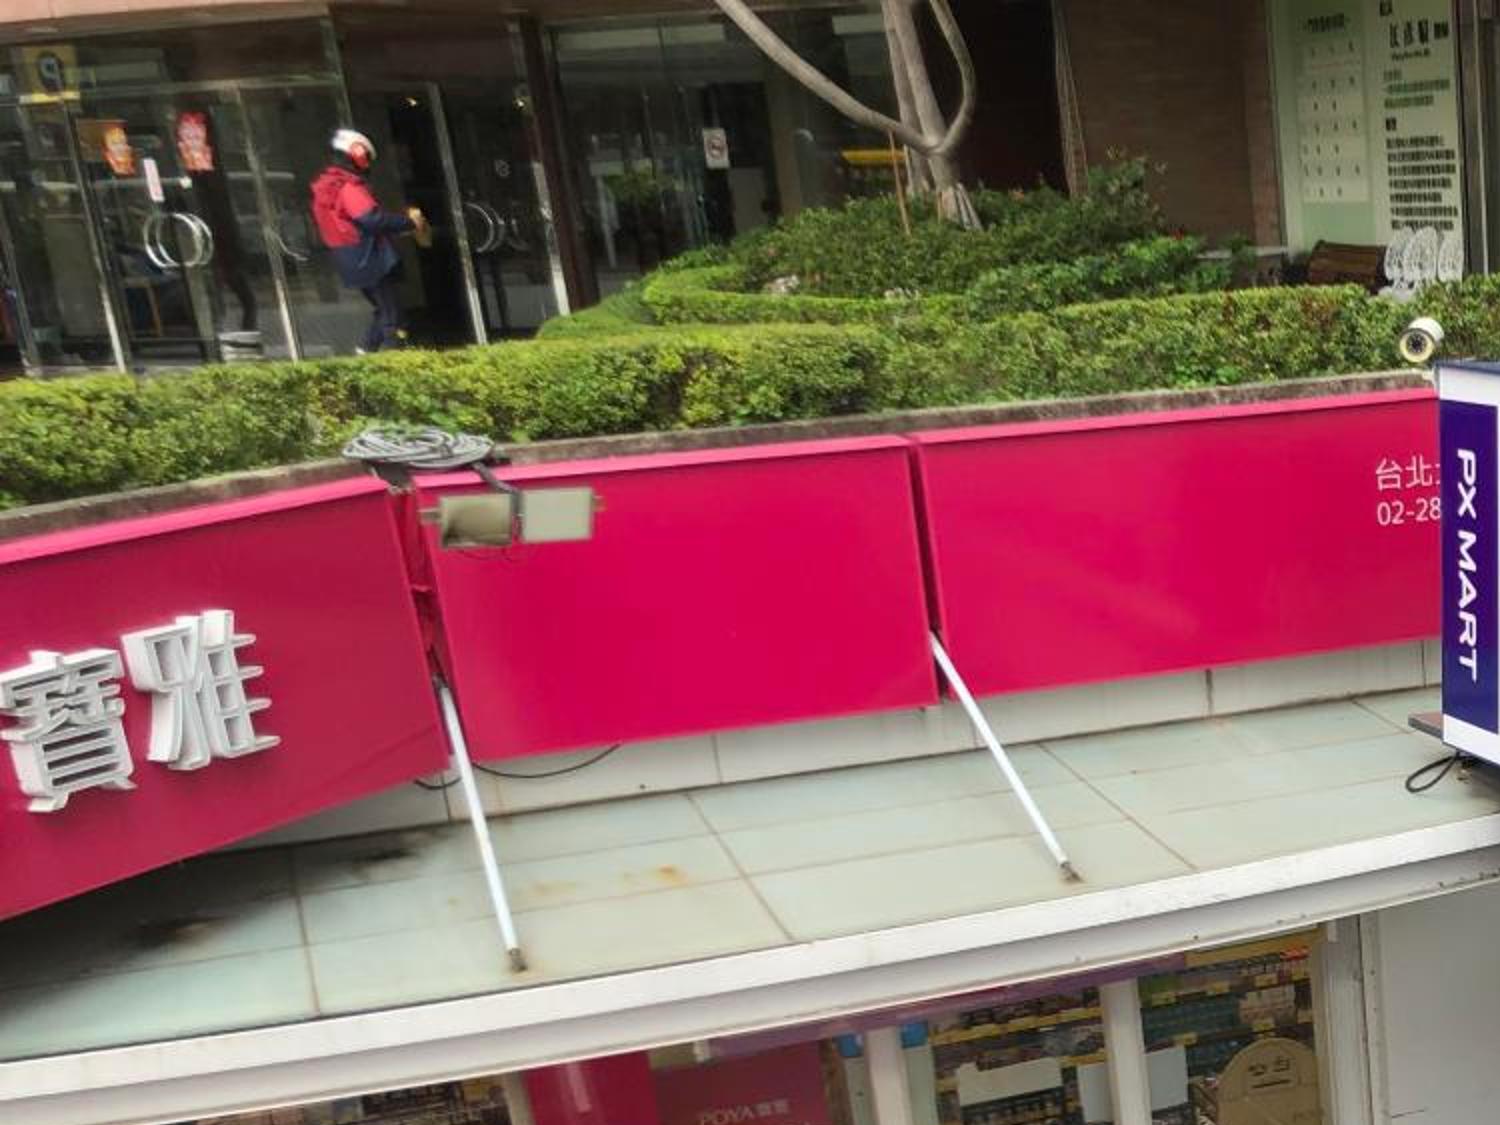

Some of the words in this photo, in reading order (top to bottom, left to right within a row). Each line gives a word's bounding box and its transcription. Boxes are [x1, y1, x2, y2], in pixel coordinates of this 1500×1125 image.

[1376, 454, 1440, 491] 台北
[1457, 448, 1478, 520] PX
[1377, 497, 1441, 526] 02-28
[1457, 531, 1478, 686] MART
[0, 609, 281, 812] 寶雅
